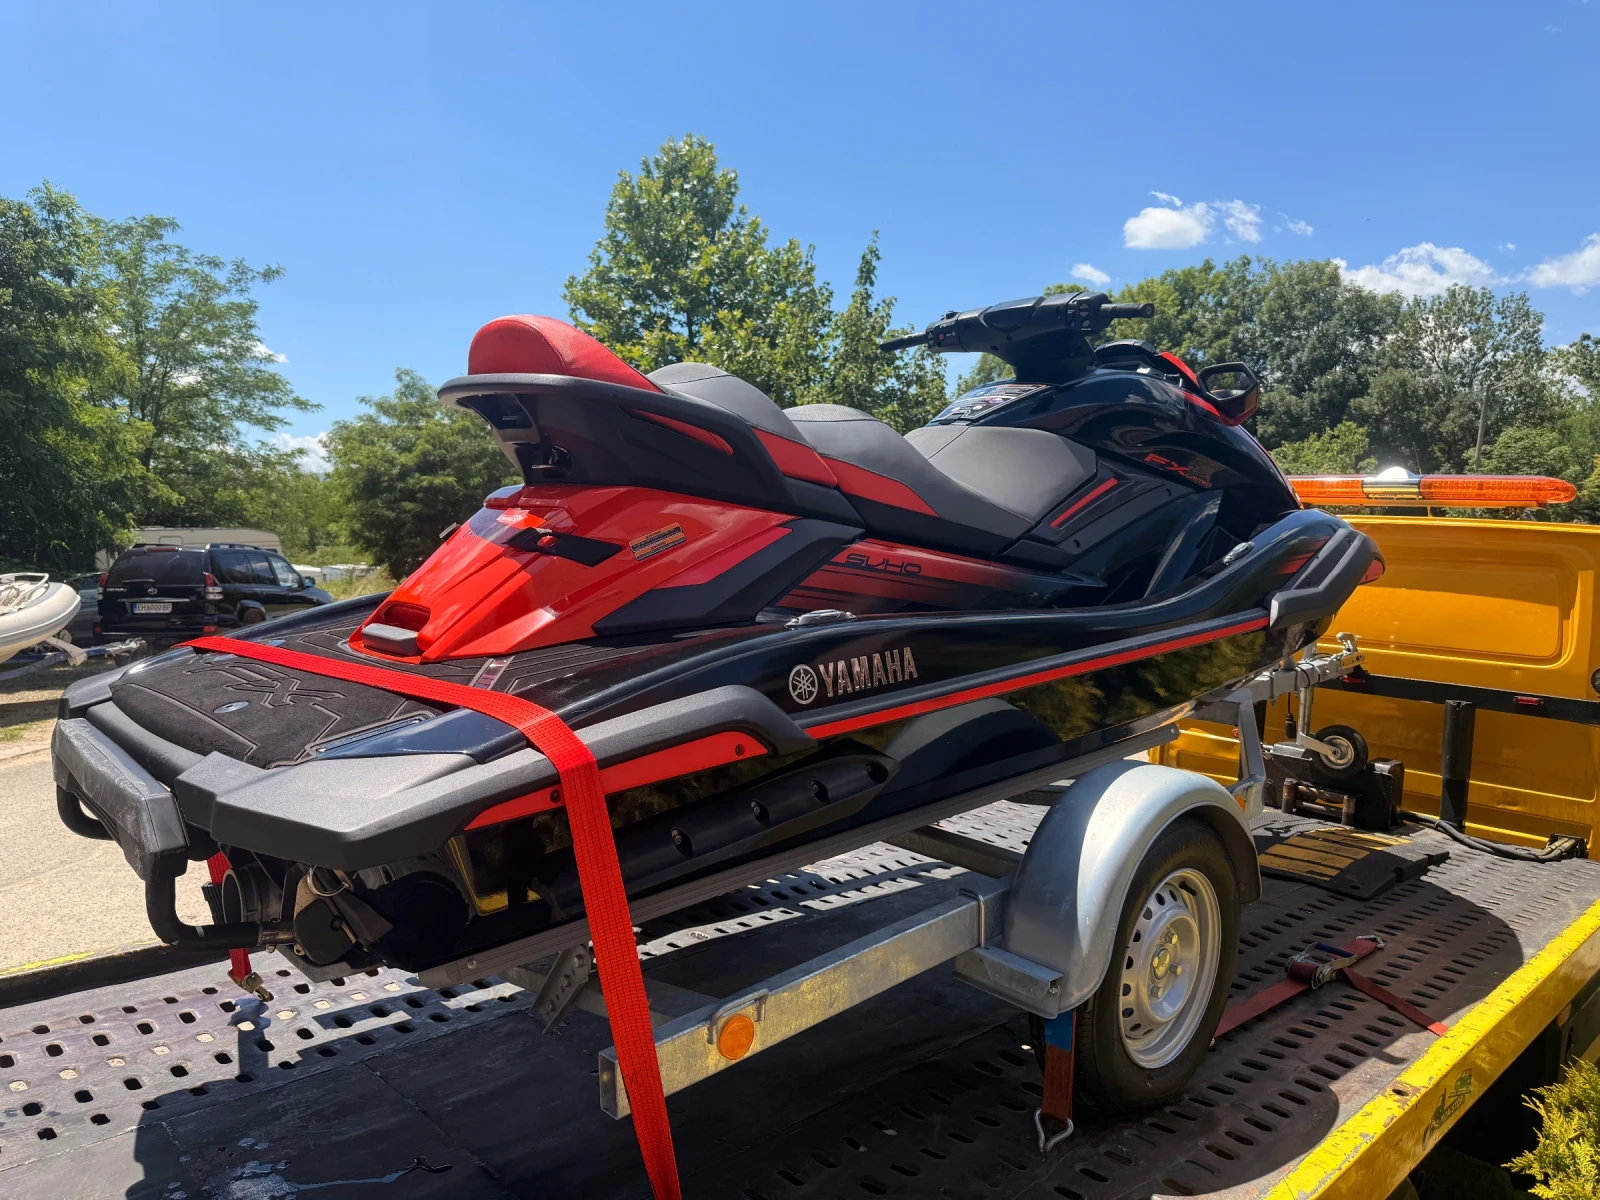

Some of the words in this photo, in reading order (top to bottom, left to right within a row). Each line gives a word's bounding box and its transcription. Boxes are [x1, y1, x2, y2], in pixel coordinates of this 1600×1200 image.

[1144, 453, 1190, 477] FX
[845, 553, 922, 575] SVHO
[818, 646, 919, 698] YAMAHA
